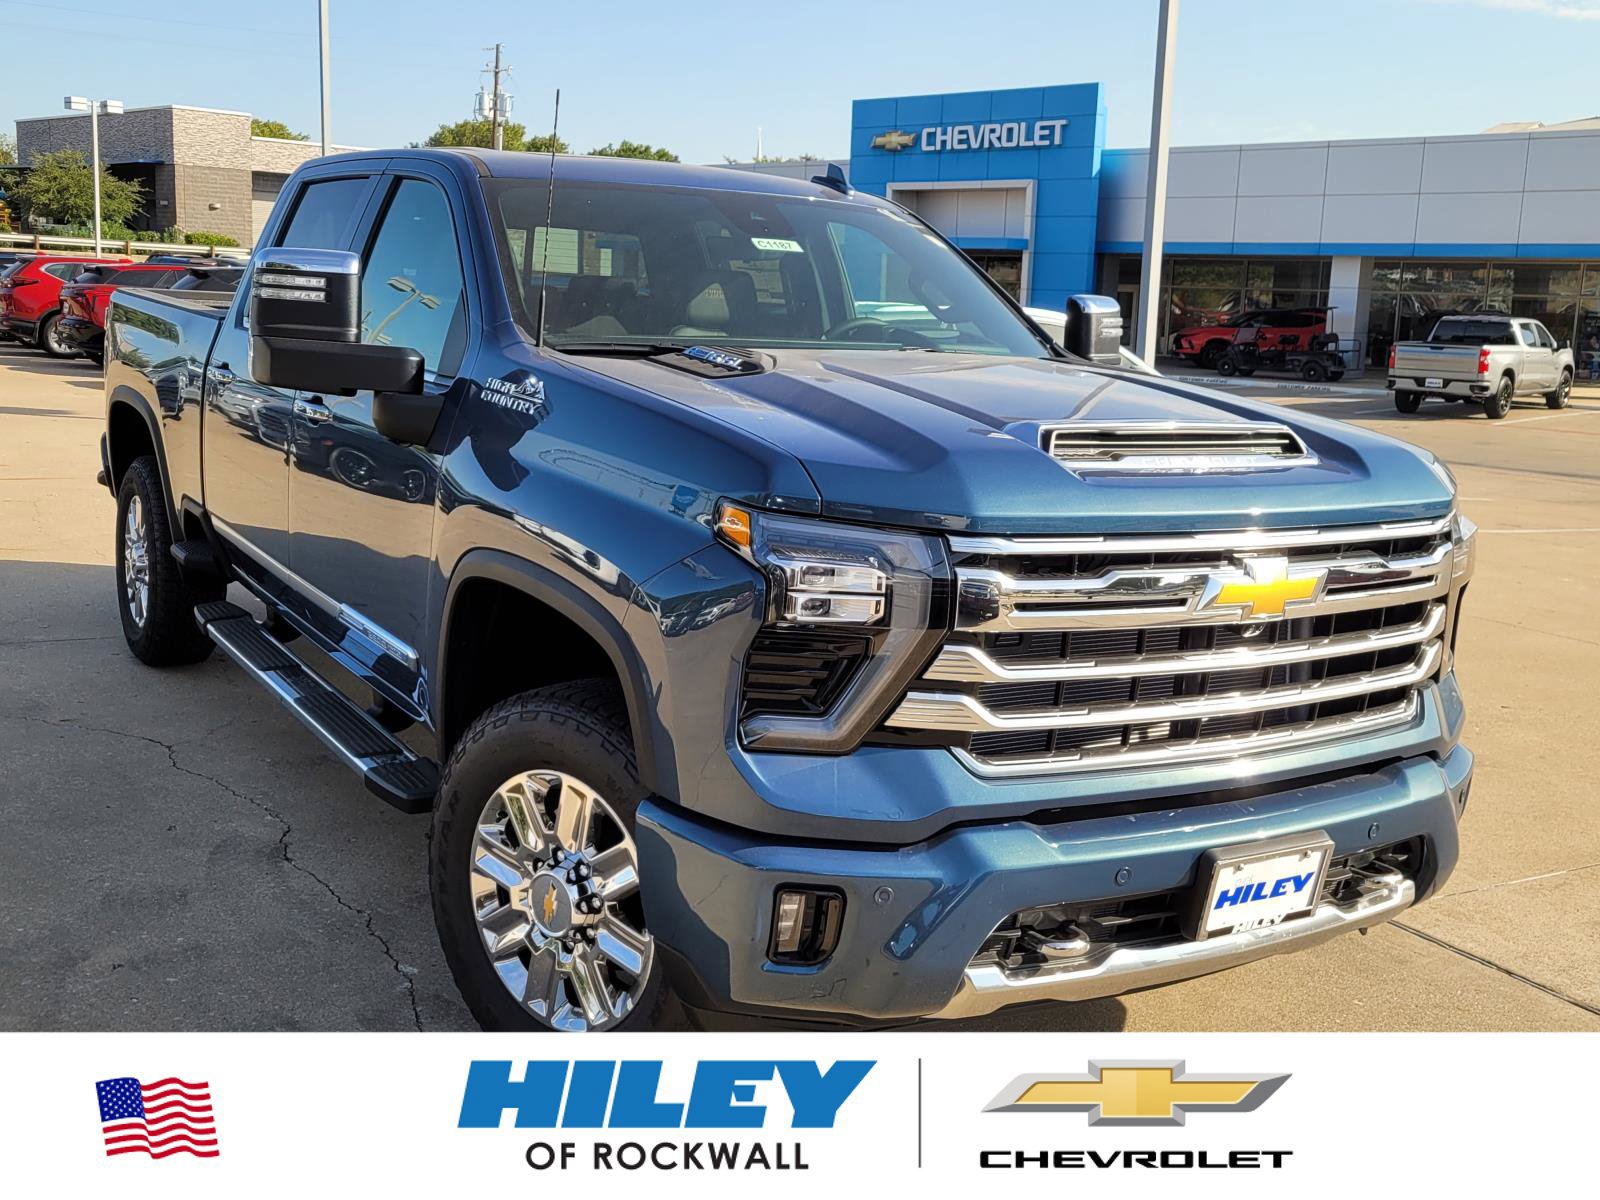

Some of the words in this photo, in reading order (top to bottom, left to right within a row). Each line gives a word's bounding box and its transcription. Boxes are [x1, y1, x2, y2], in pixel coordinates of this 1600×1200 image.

[921, 119, 1068, 151] CHEVROLET
[757, 240, 793, 250] C1187
[485, 377, 517, 395] HIGH
[480, 389, 541, 415] COUNTRY
[1213, 871, 1315, 911] HILEY
